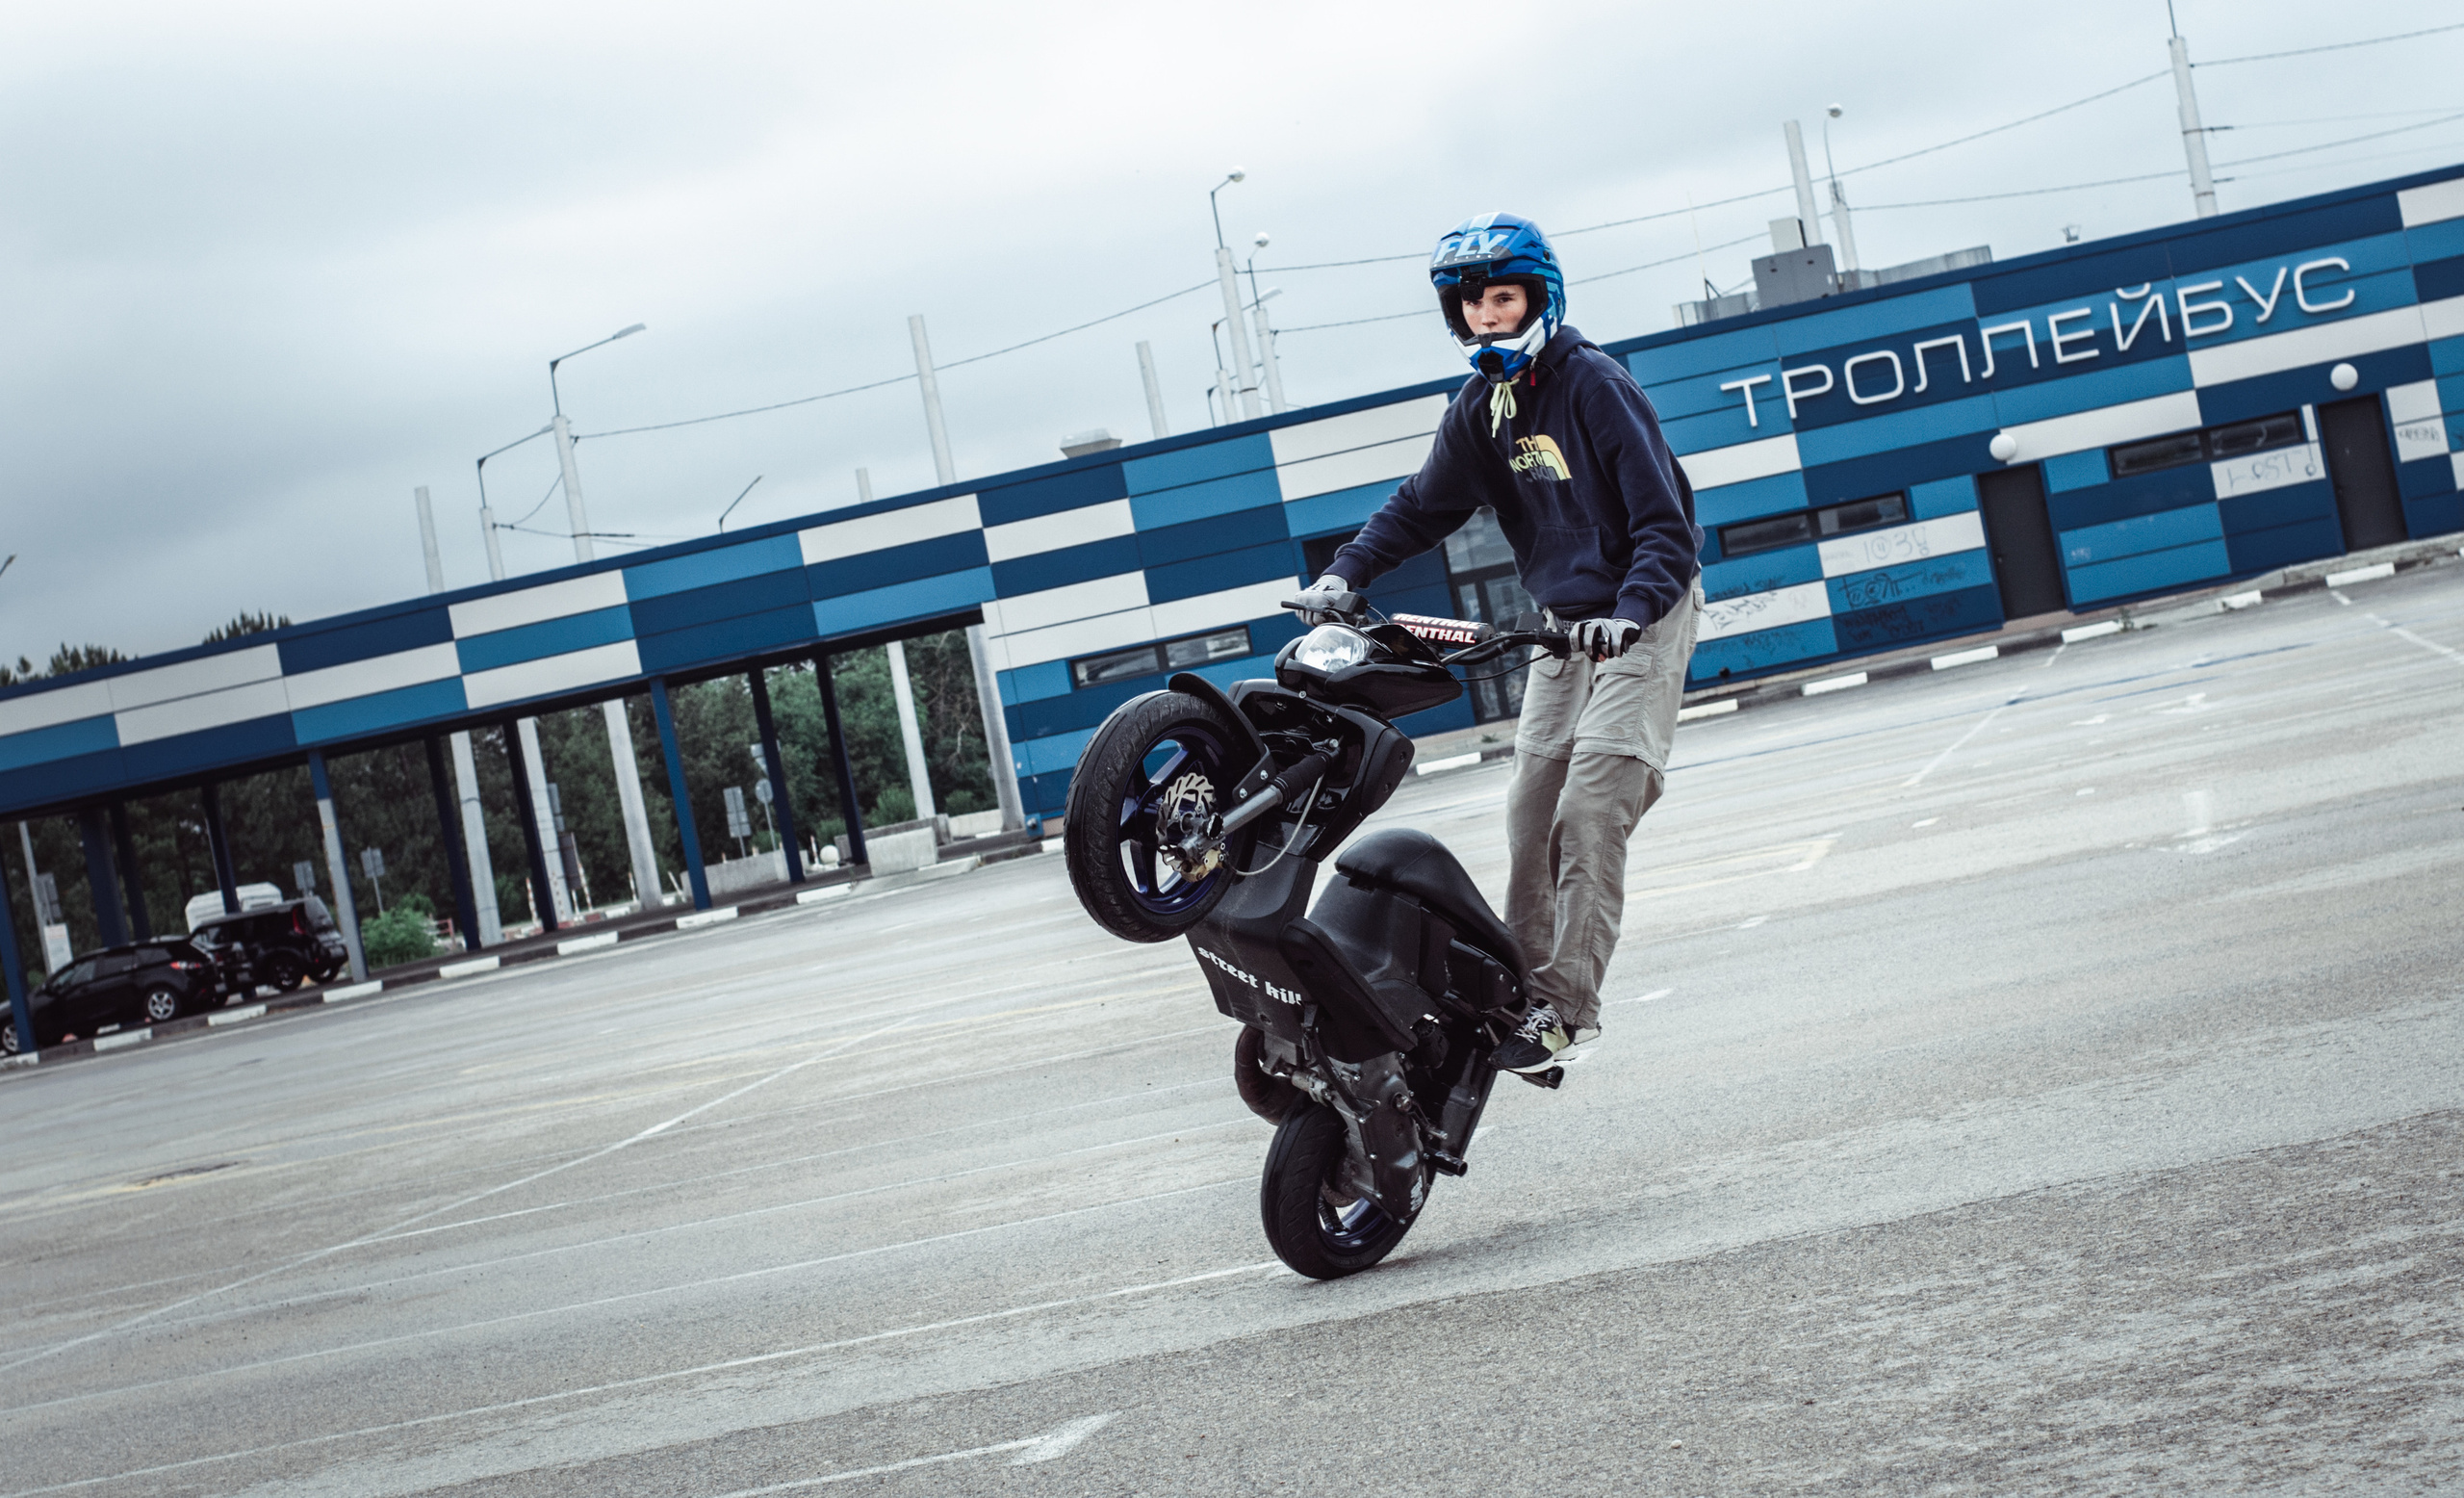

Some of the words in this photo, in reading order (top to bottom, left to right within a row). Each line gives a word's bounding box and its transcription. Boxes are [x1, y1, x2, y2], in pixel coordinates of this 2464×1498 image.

[1433, 232, 1508, 264] FLY
[1720, 256, 2355, 427] ТРОЛЛЕЙБУС
[1395, 623, 1476, 644] ENTHAL
